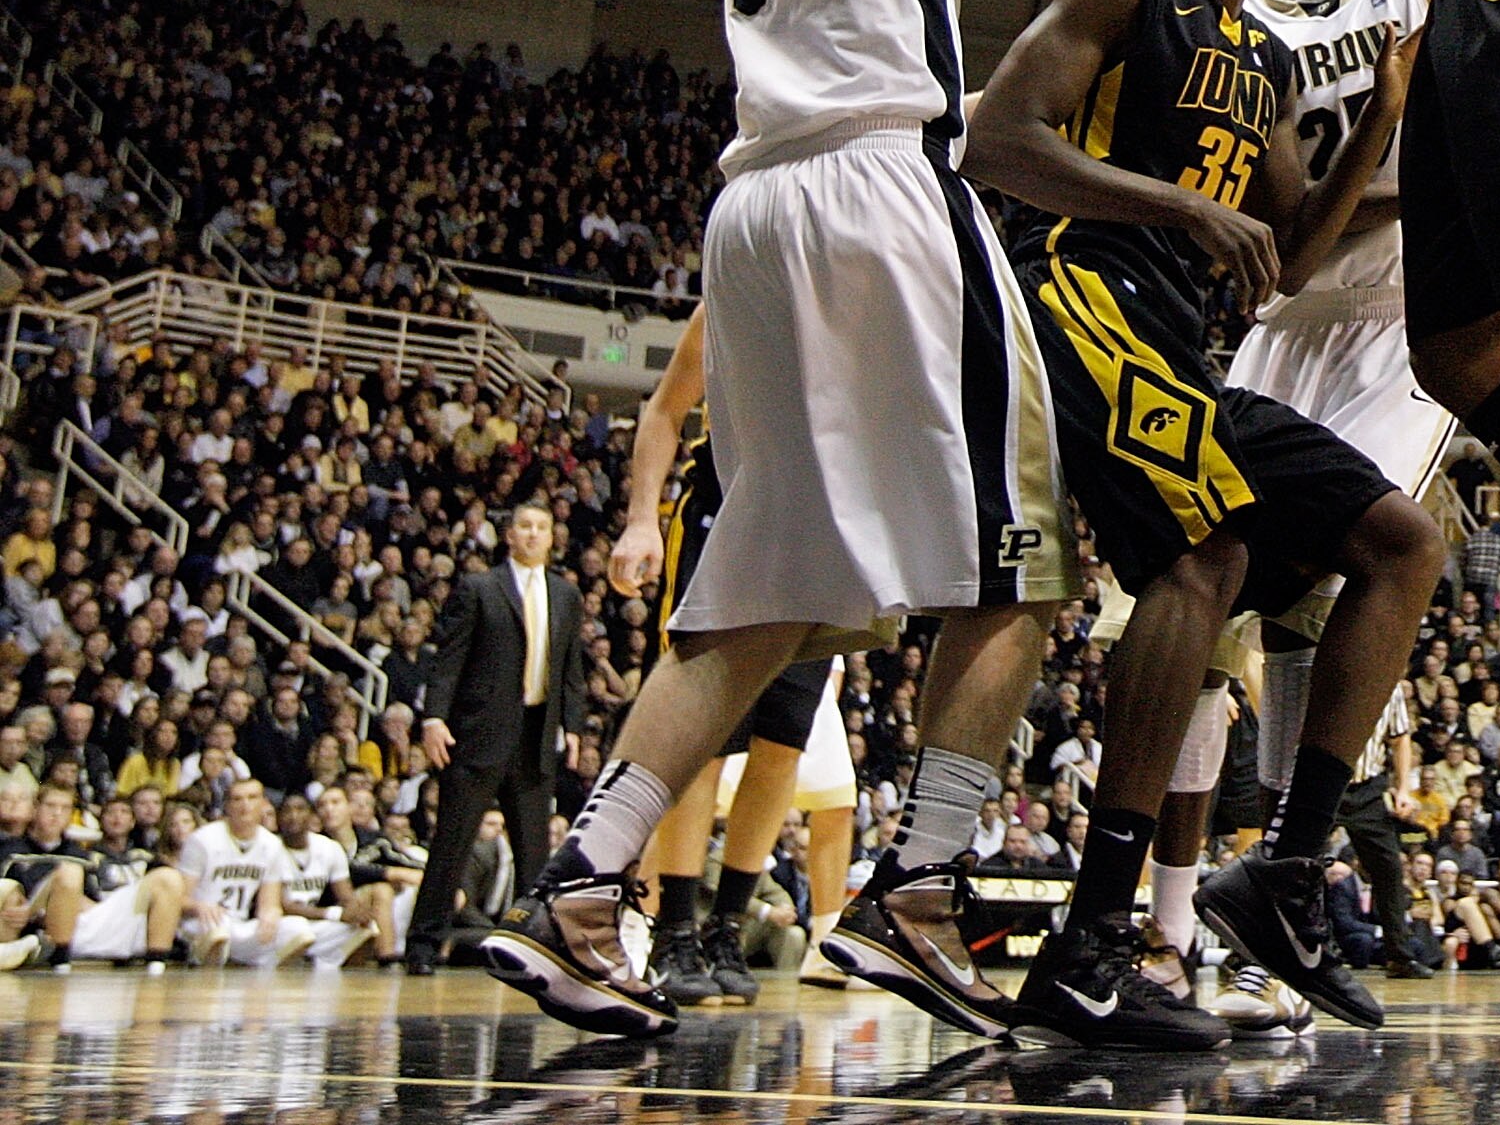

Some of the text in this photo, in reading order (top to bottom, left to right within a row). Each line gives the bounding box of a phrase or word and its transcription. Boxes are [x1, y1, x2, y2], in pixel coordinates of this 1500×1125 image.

[1177, 125, 1260, 212] 35
[607, 323, 628, 341] 10
[217, 885, 245, 912] 21
